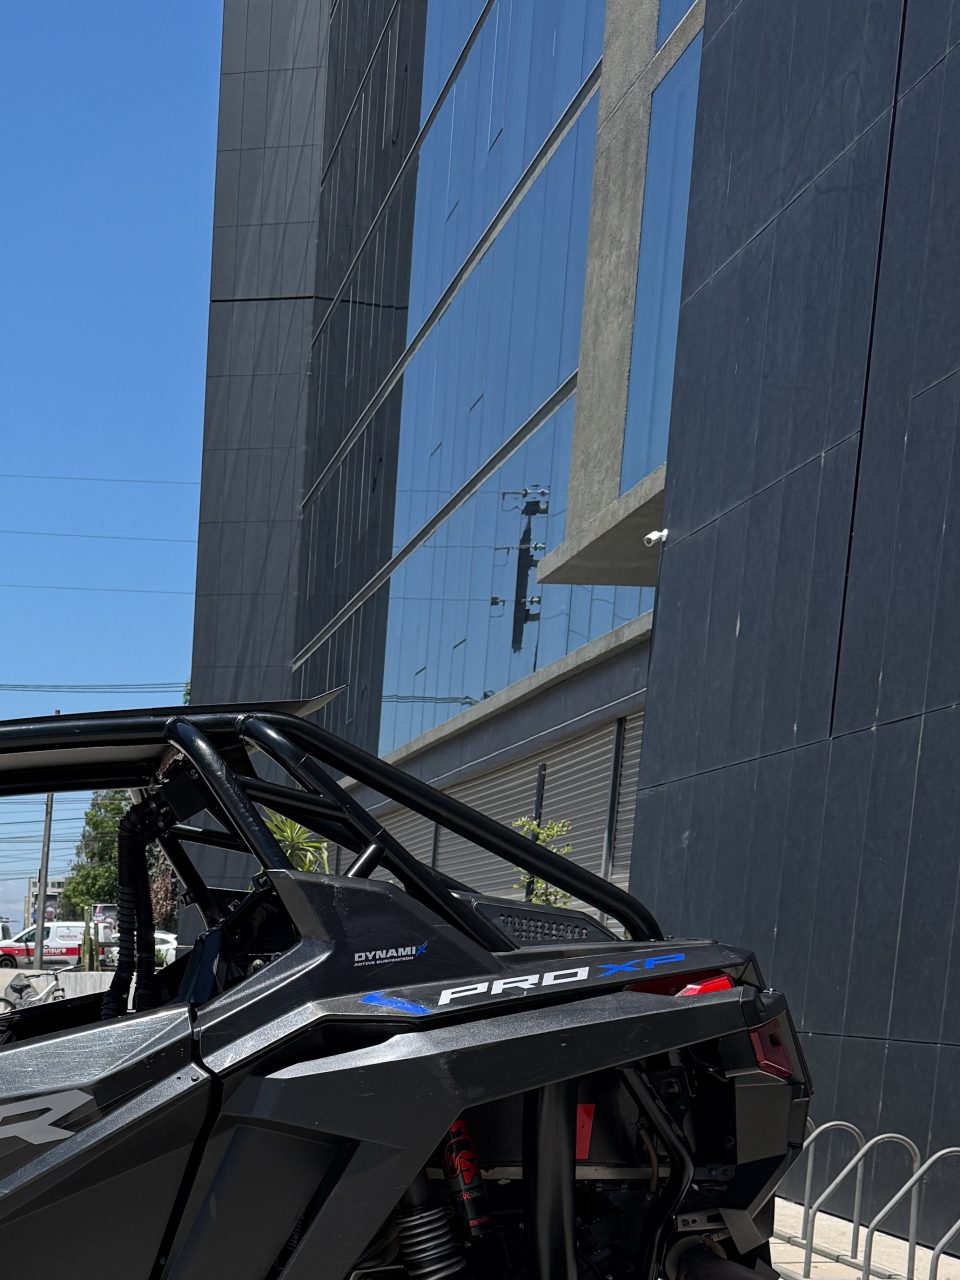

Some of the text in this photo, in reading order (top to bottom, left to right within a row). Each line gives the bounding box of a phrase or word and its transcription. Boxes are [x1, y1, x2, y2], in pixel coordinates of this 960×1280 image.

[354, 939, 429, 962] DYNAMIX
[438, 953, 685, 1006] PRO XP
